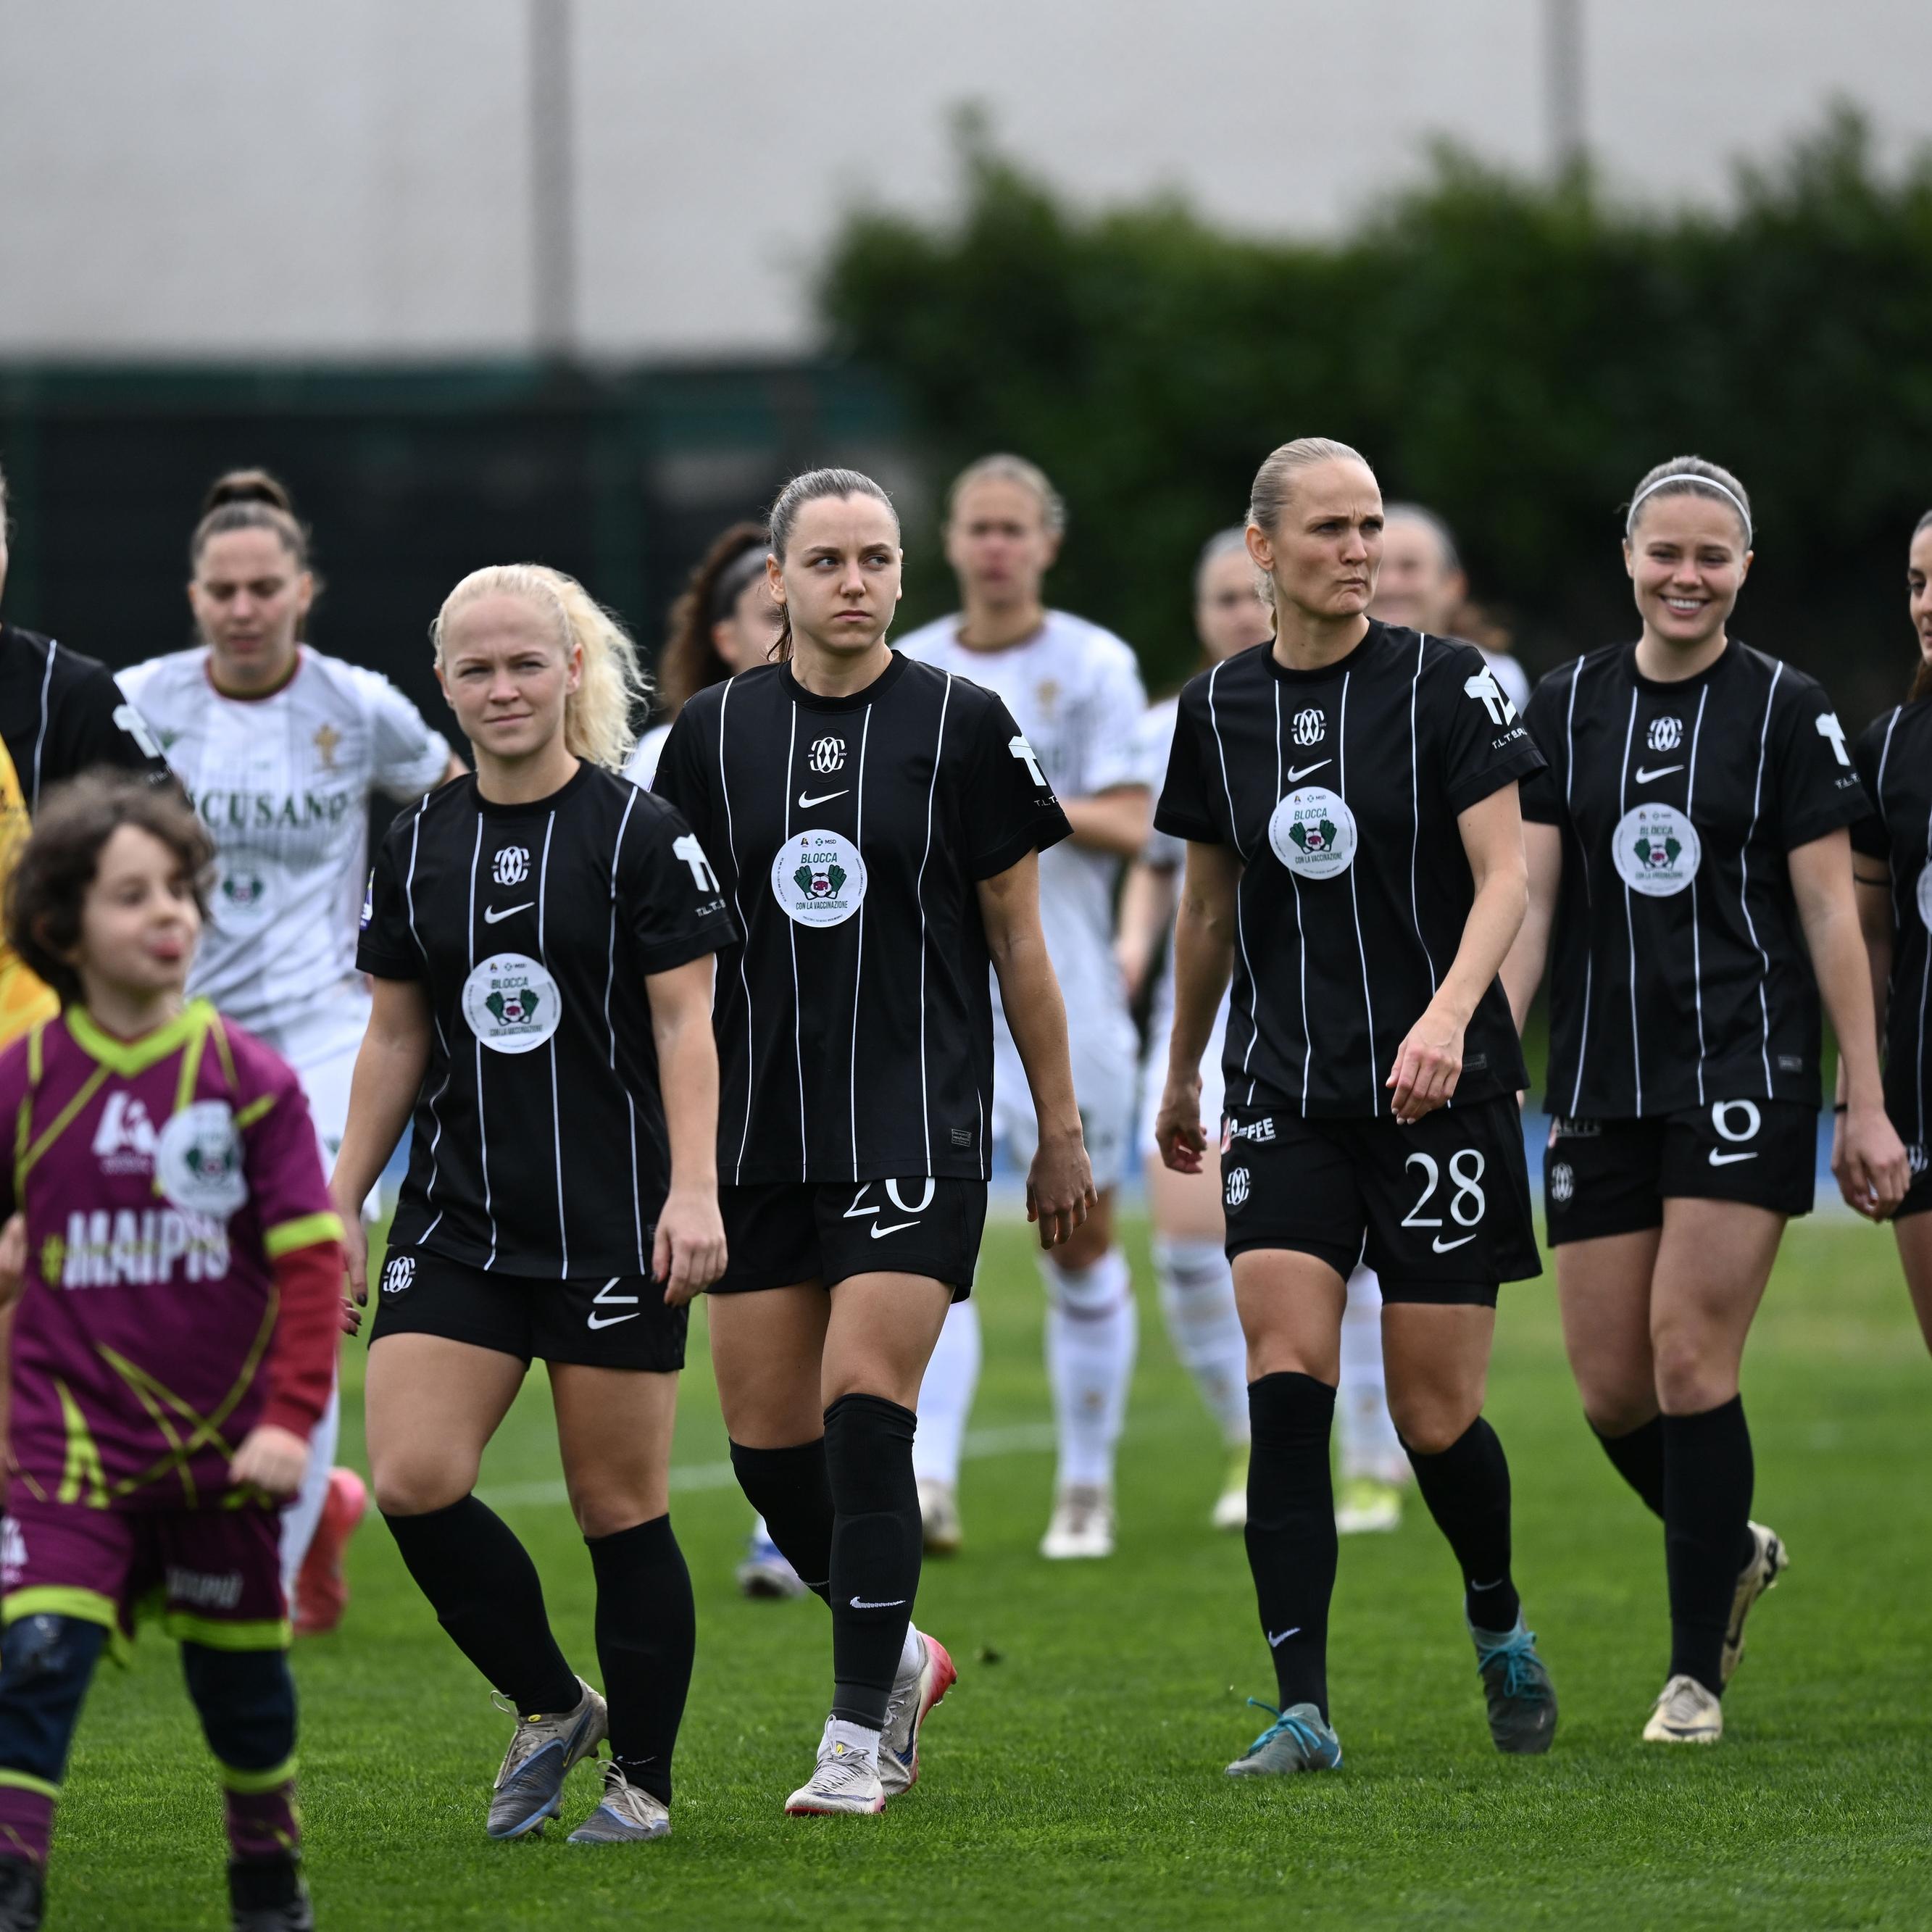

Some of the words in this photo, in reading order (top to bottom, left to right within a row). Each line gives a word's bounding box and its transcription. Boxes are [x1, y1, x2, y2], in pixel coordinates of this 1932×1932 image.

[1294, 808, 1327, 820] BLOCCA
[801, 852, 837, 863] BLOCCA
[1312, 852, 1343, 862] VACCINAZIONE
[796, 902, 806, 910] CON
[807, 901, 813, 909] LA
[813, 900, 848, 909] VACCINAZIONE
[491, 976, 528, 989] BLOCCA
[1401, 1149, 1486, 1227] 28
